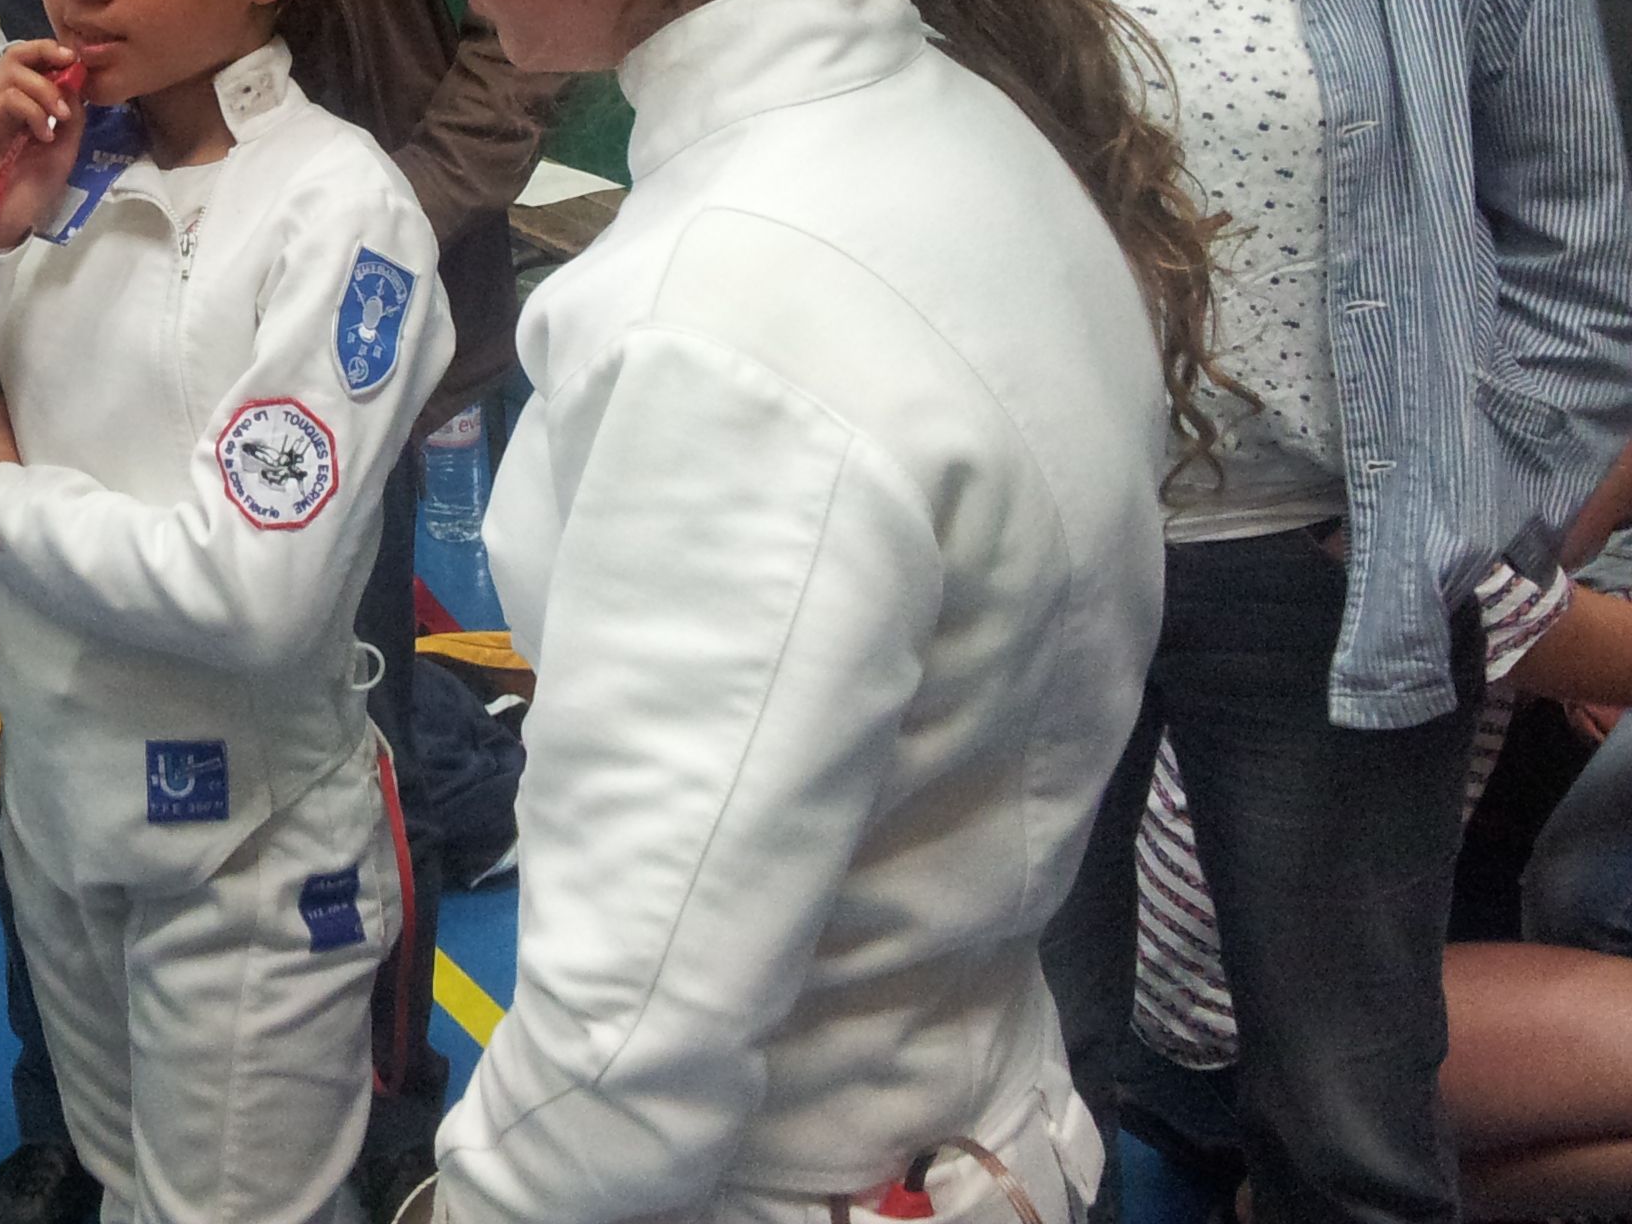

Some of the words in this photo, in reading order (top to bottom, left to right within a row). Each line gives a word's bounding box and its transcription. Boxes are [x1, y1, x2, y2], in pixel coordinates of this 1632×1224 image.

[283, 410, 328, 460] TOUQUES
[243, 494, 280, 519] Fleurie
[292, 464, 329, 515] ESCRIME
